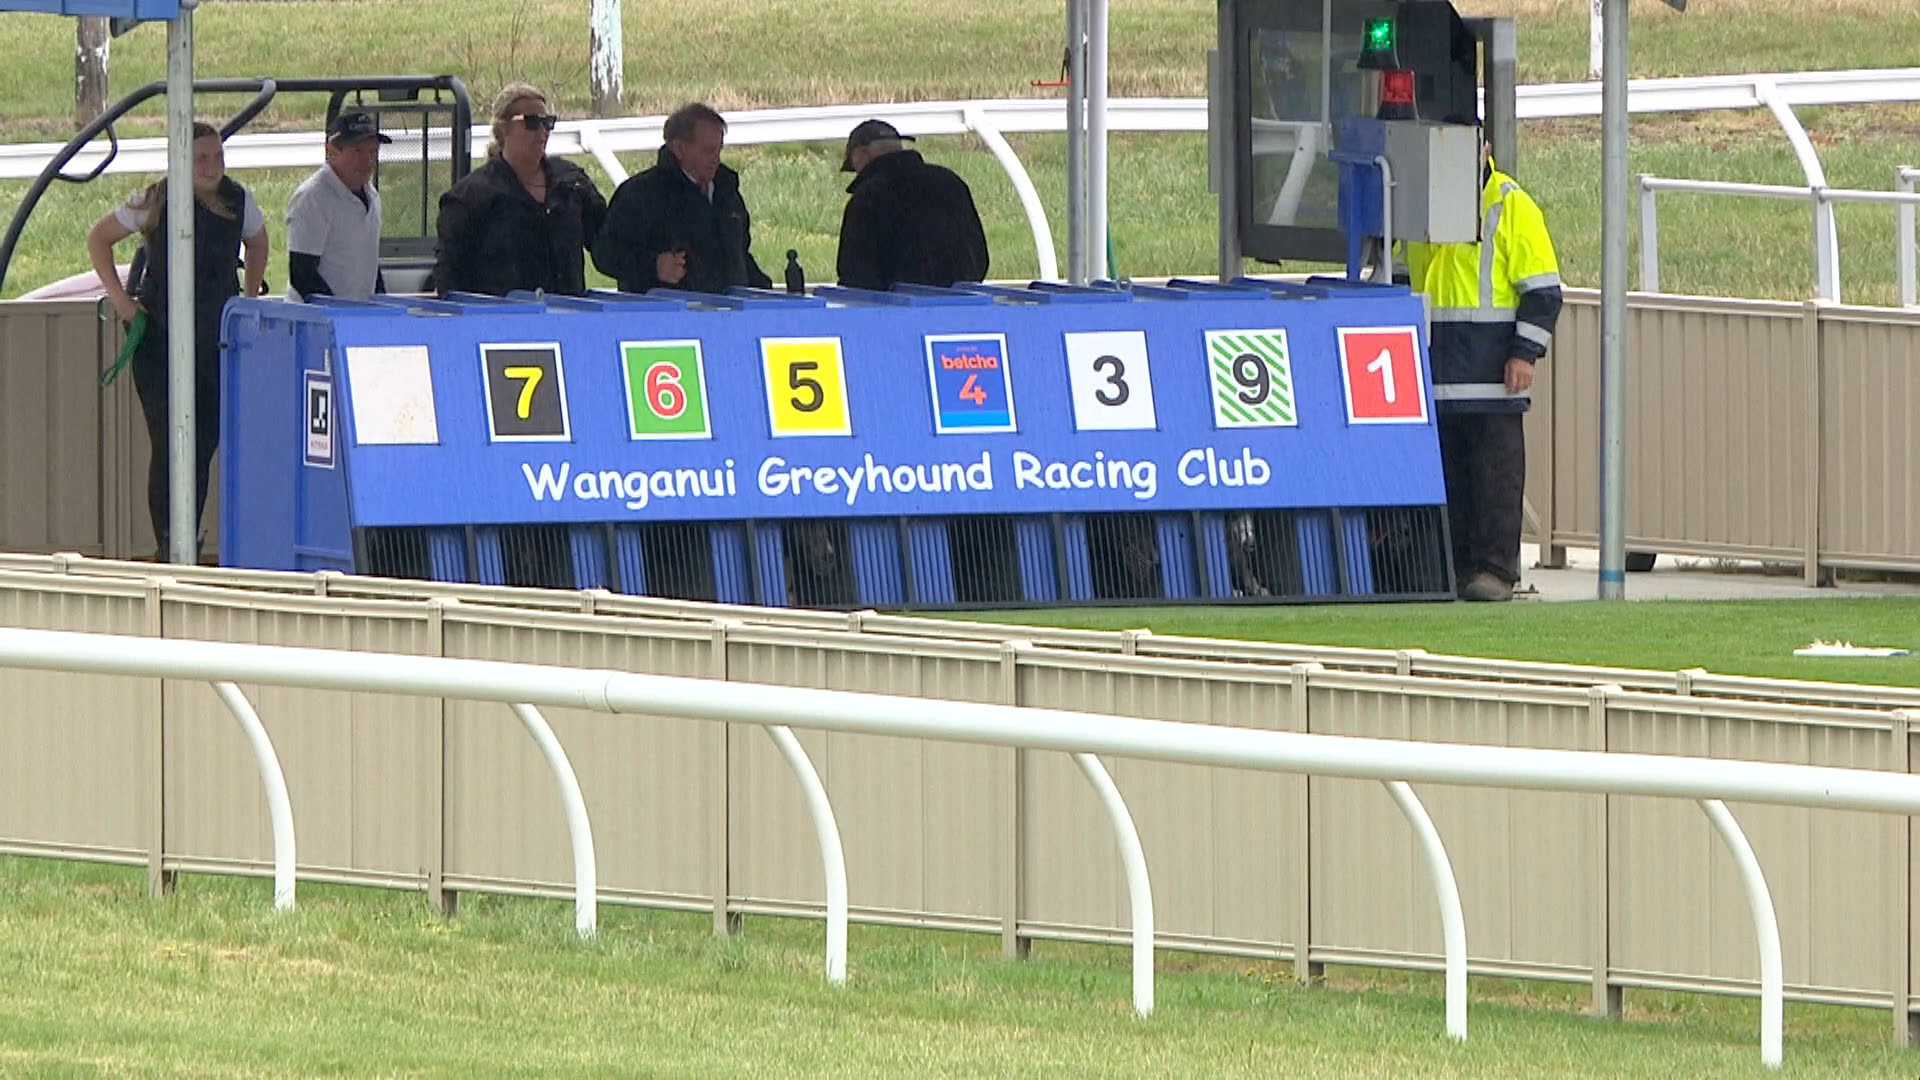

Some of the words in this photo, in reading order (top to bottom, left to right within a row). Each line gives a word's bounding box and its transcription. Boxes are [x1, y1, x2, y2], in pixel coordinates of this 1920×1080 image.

[788, 361, 825, 413] 5
[941, 354, 1000, 370] betcha
[1093, 355, 1130, 407] 3
[1233, 354, 1270, 405] 9
[1366, 348, 1396, 404] 1
[503, 366, 543, 420] 7
[643, 361, 687, 420] 6
[959, 374, 988, 406] 4
[522, 459, 736, 510] Wanganui
[758, 451, 994, 505] Greyhound
[1013, 451, 1158, 501] Racing
[1177, 447, 1272, 488] Club
